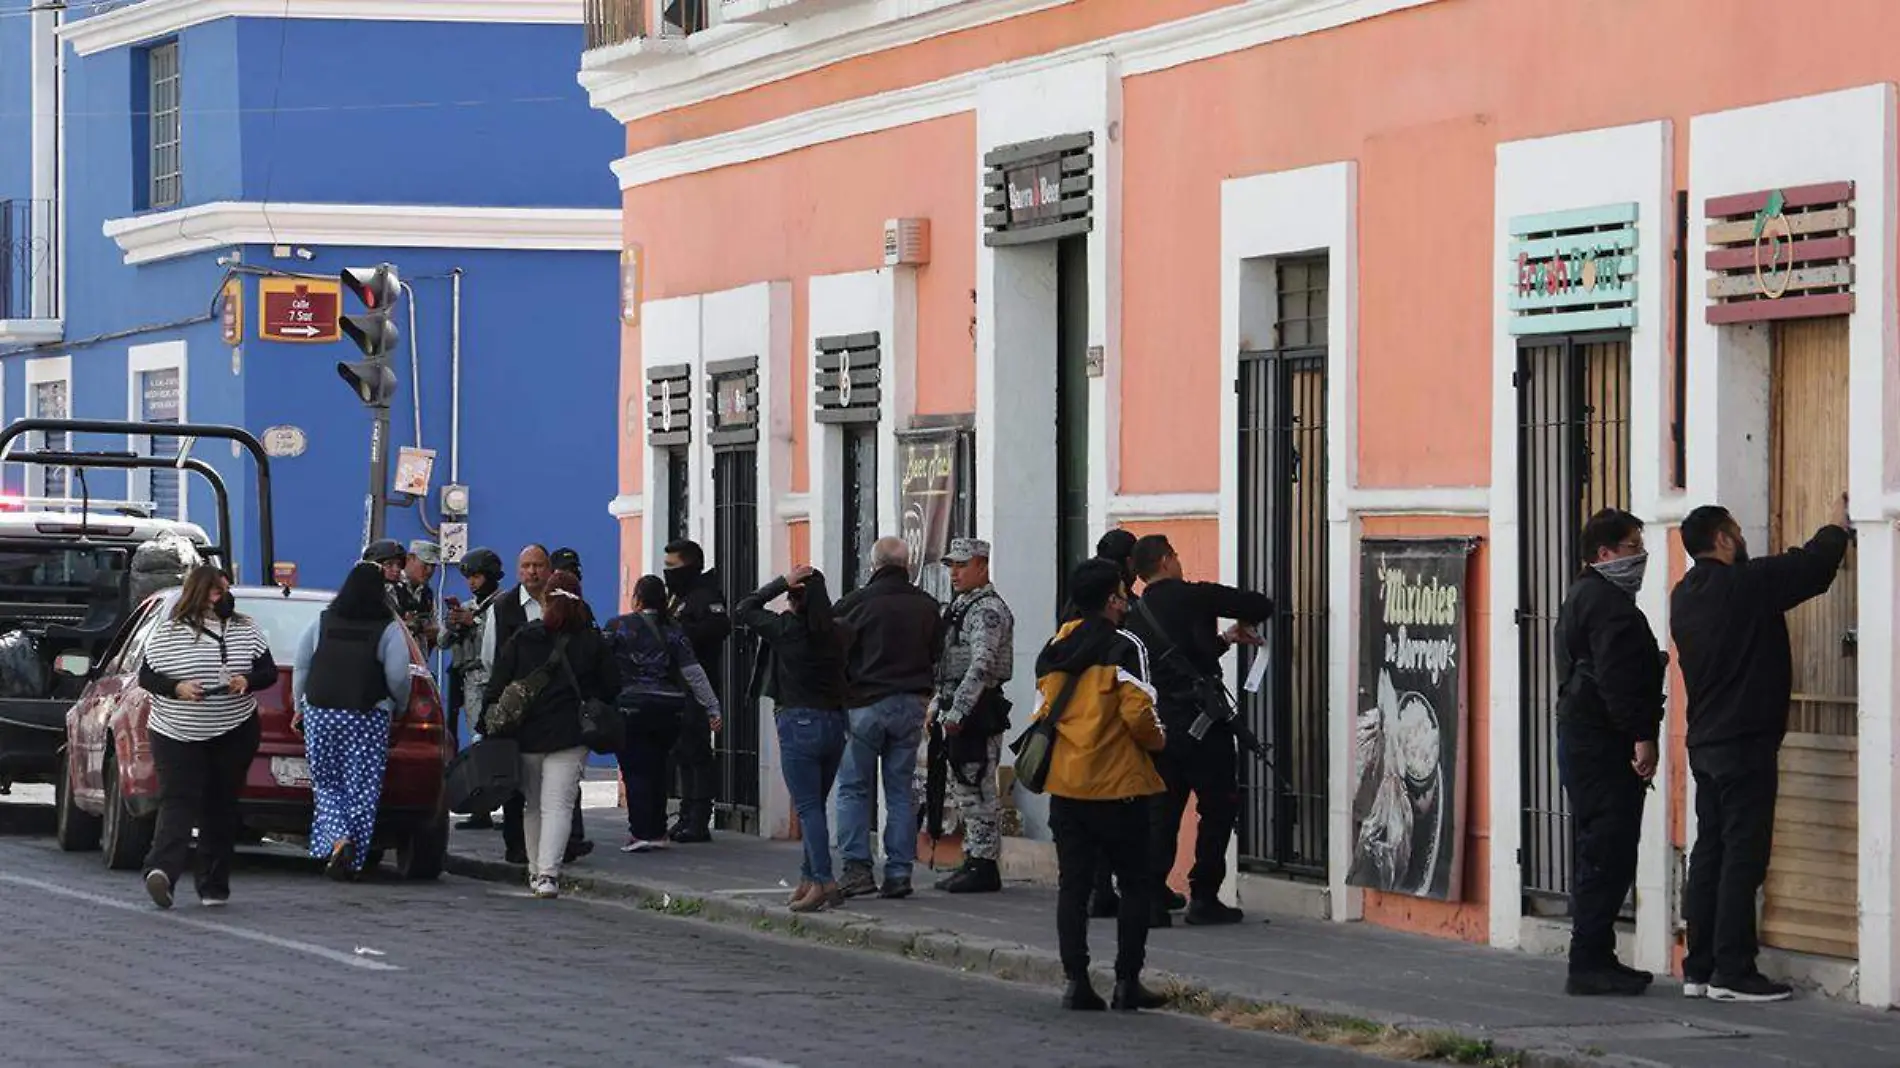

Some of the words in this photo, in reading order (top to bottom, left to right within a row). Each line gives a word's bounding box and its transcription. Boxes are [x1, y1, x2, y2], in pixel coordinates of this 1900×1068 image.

[1518, 249, 1567, 298] Fresh
[292, 299, 310, 308] Calle
[288, 310, 295, 321] 7
[297, 310, 313, 321] Sur
